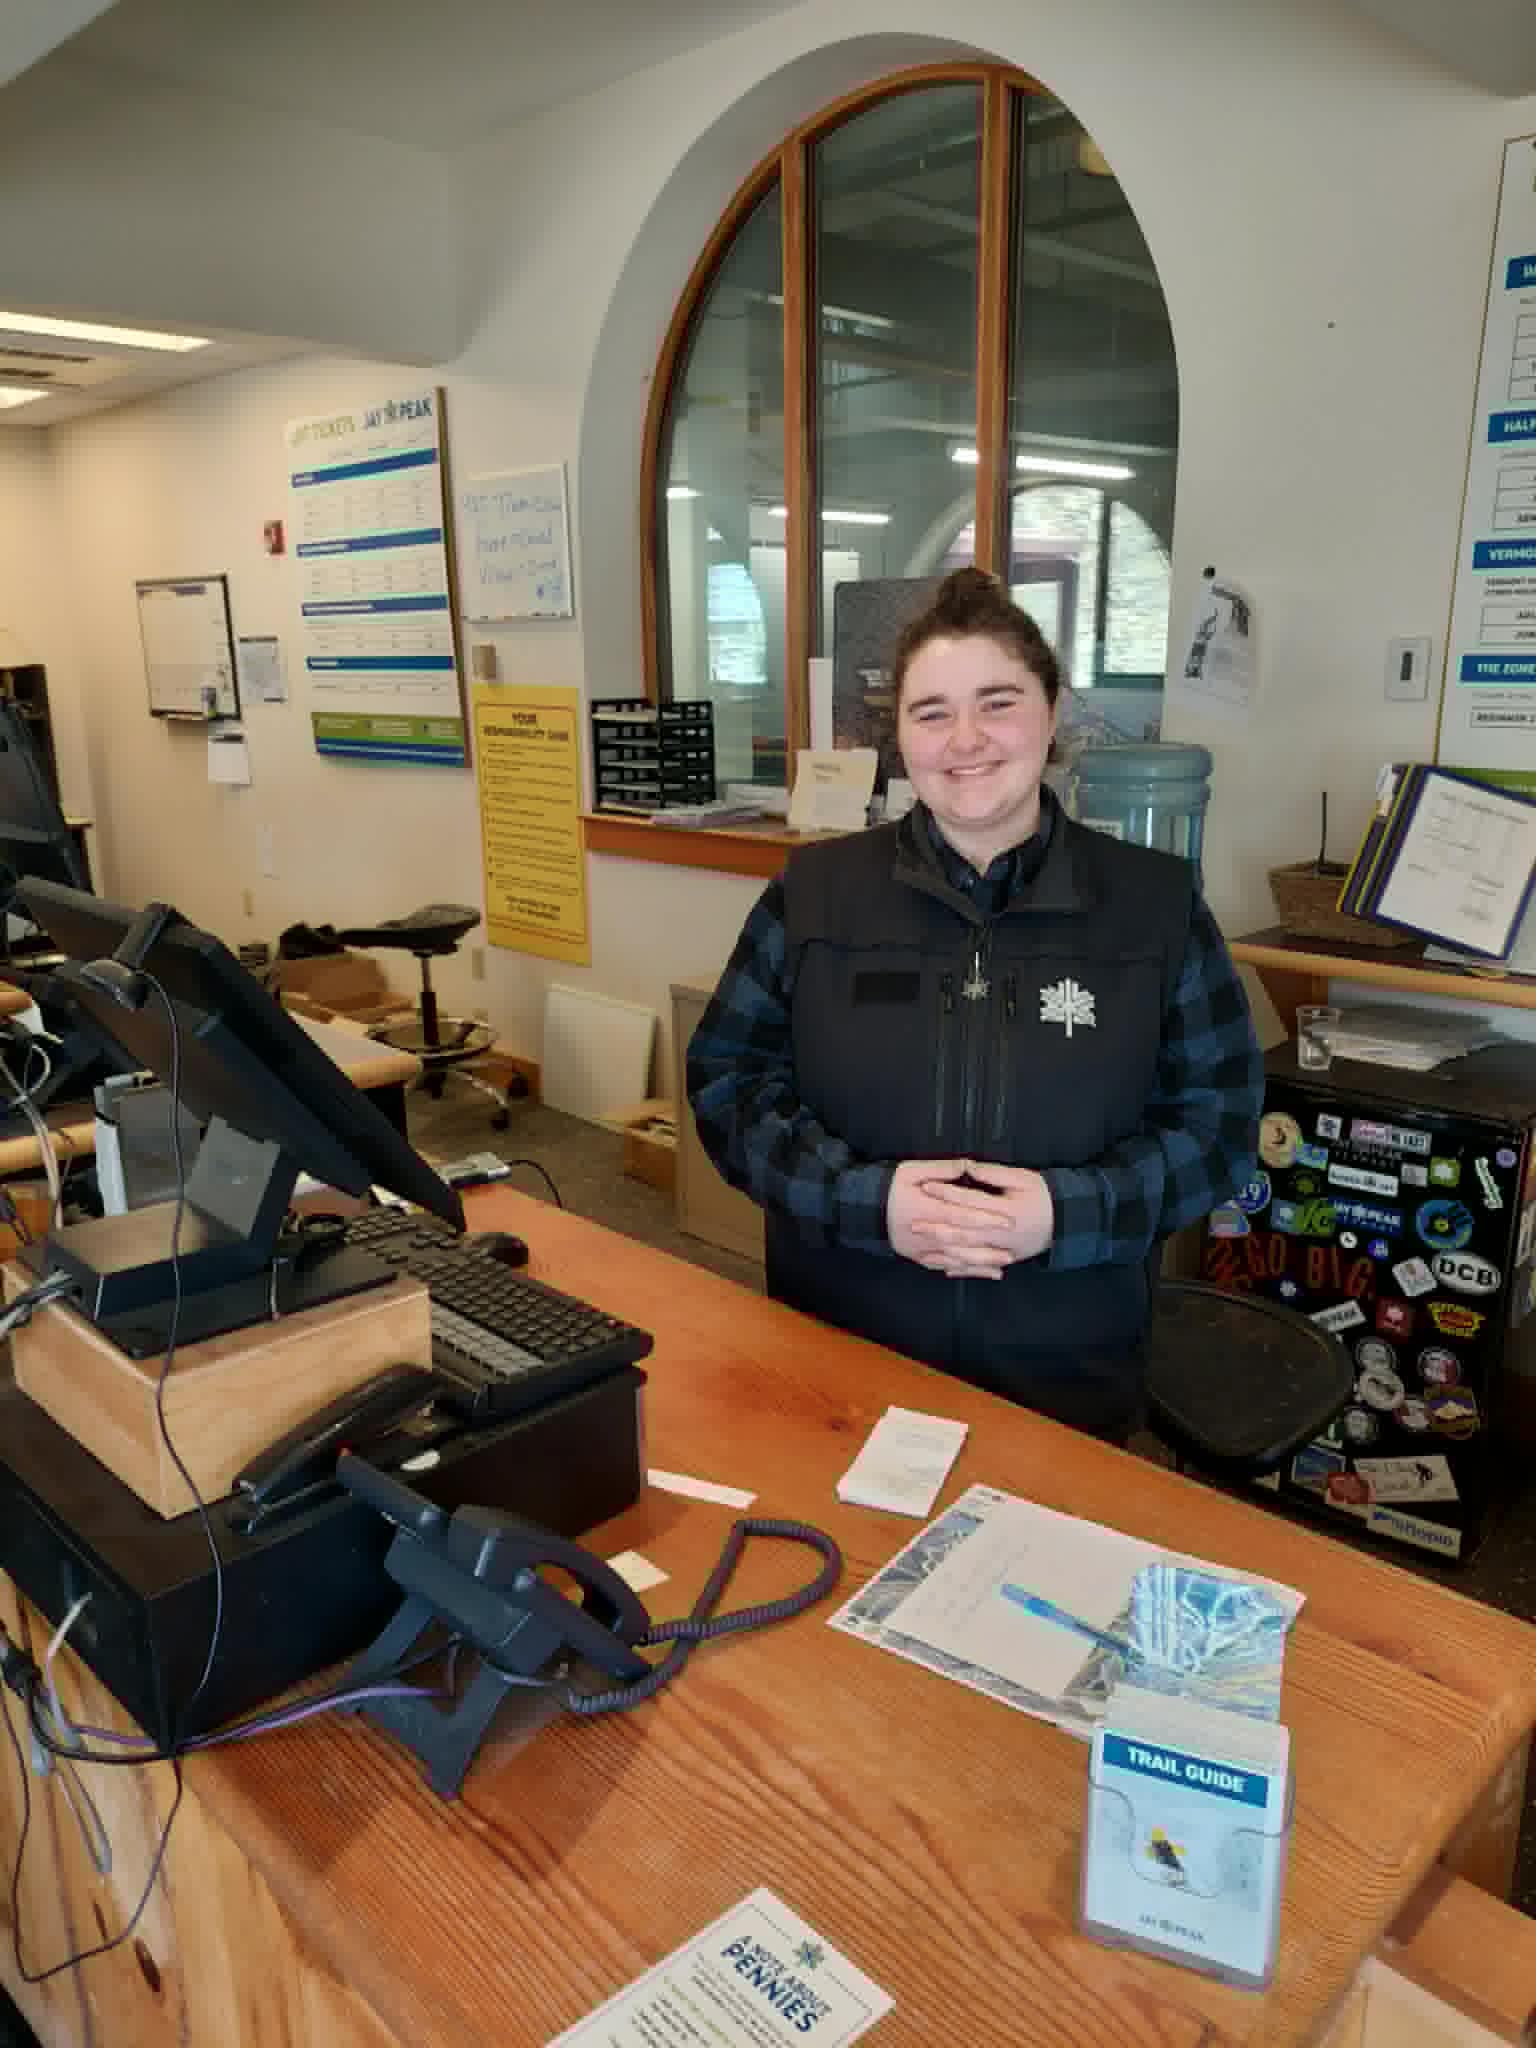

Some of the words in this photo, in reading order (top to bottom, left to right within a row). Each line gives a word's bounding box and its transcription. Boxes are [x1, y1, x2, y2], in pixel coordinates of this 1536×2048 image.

[400, 397, 432, 420] PEAK
[1127, 1746, 1182, 1777] TRAIL
[1184, 1763, 1246, 1793] GUIDE
[720, 1942, 819, 2033] PENNIES
[752, 1943, 787, 1978] NOTE
[782, 1975, 832, 2017] ABOUT
